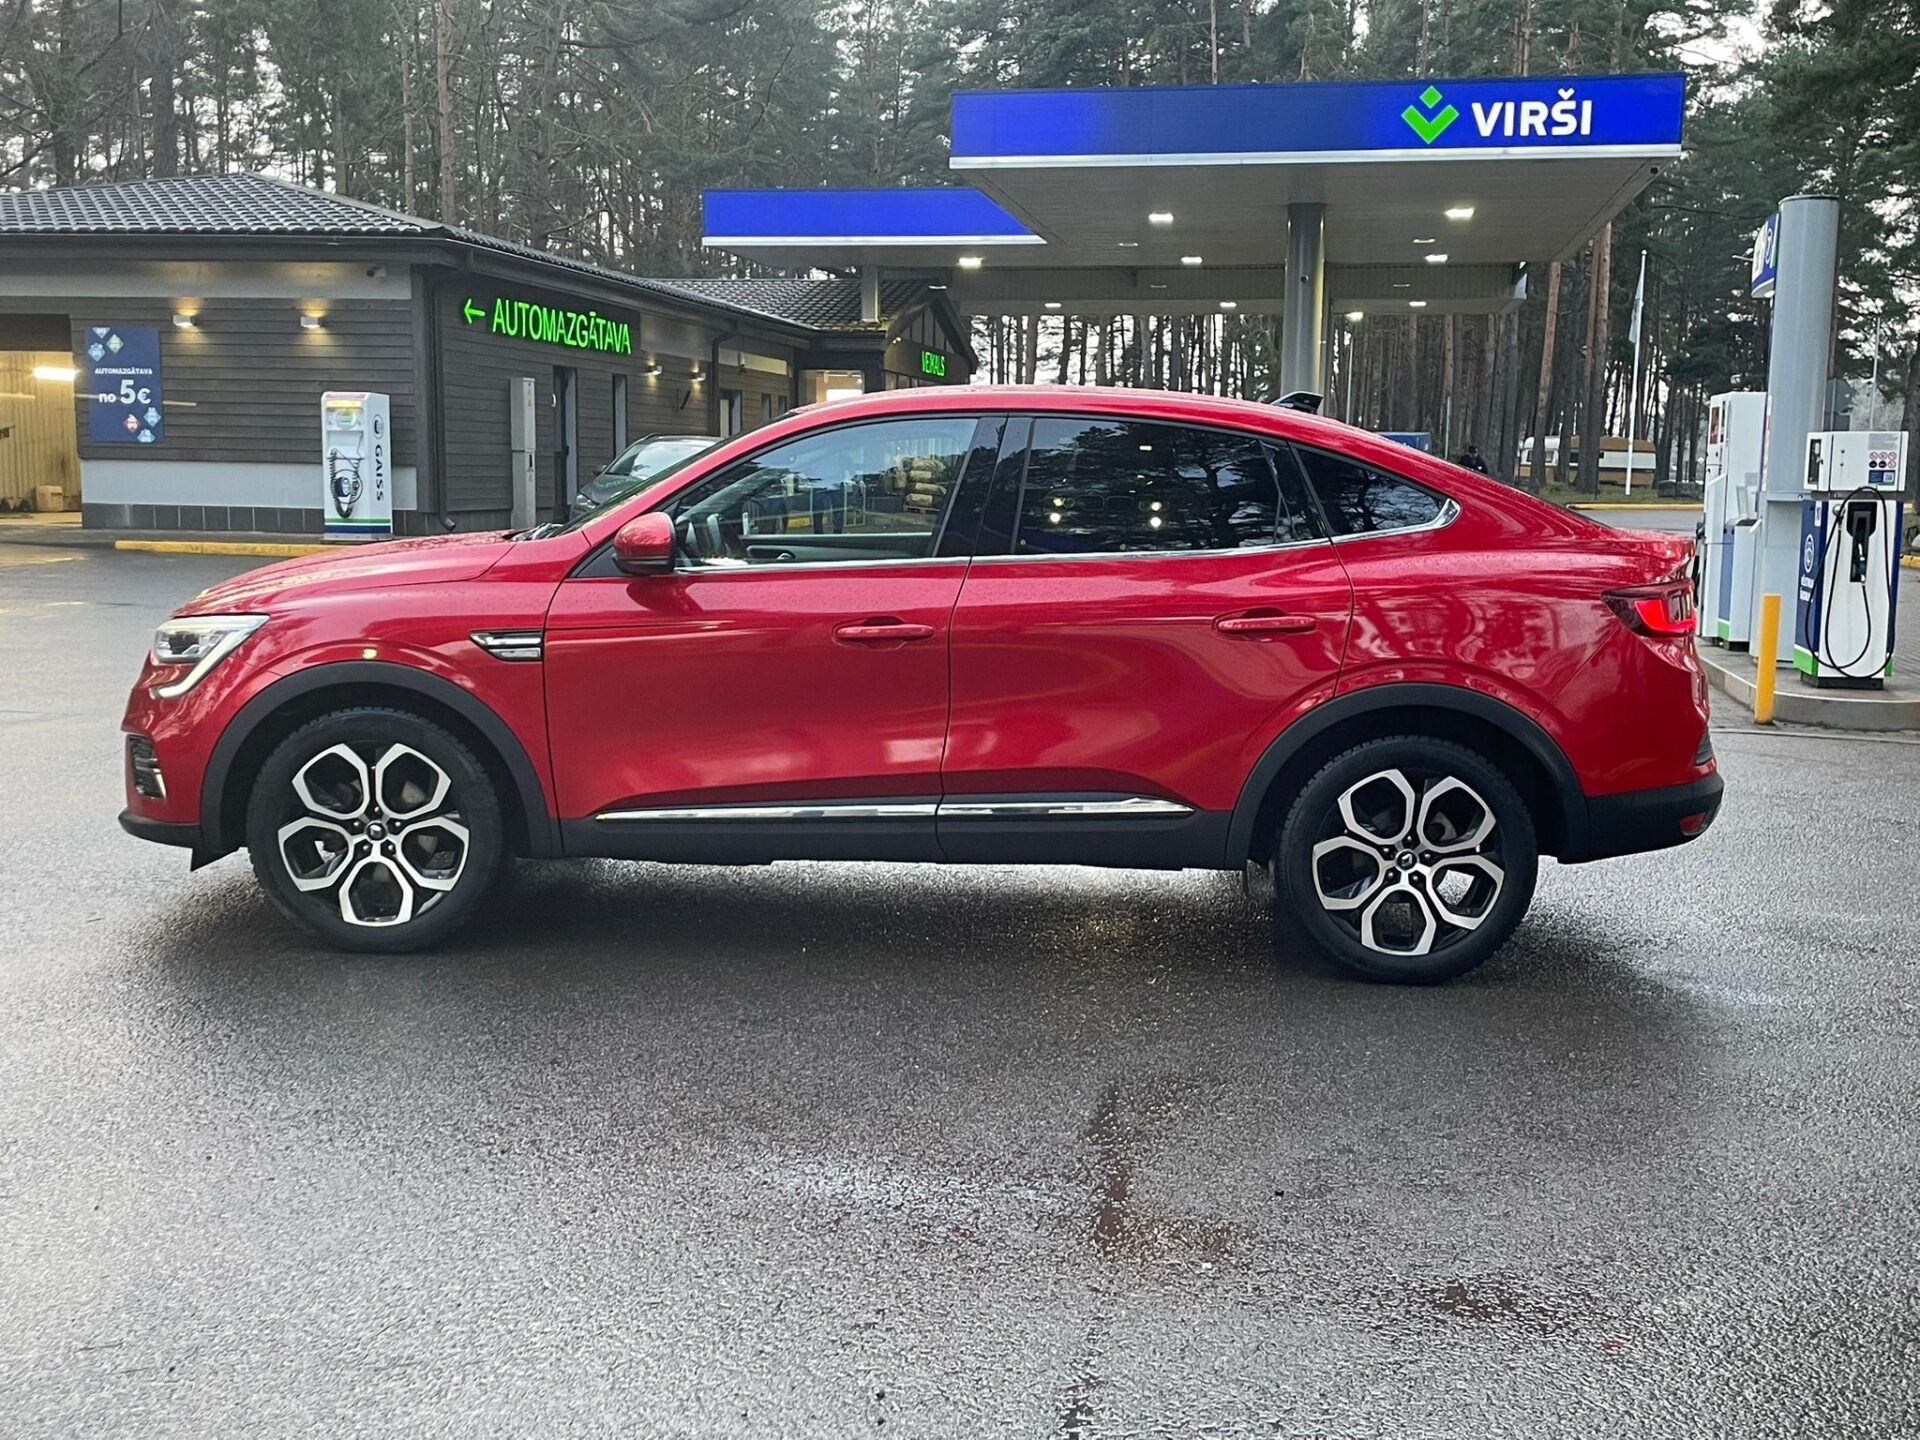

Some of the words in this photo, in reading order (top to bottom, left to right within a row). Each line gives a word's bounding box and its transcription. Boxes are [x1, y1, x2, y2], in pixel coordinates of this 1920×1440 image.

[1472, 88, 1592, 137] VIRŠI
[493, 298, 632, 354] AUTOMAZGĀTAVA
[95, 367, 153, 375] AUTOMAZGĀTAVA
[99, 393, 117, 403] no
[375, 444, 384, 501] GAISS
